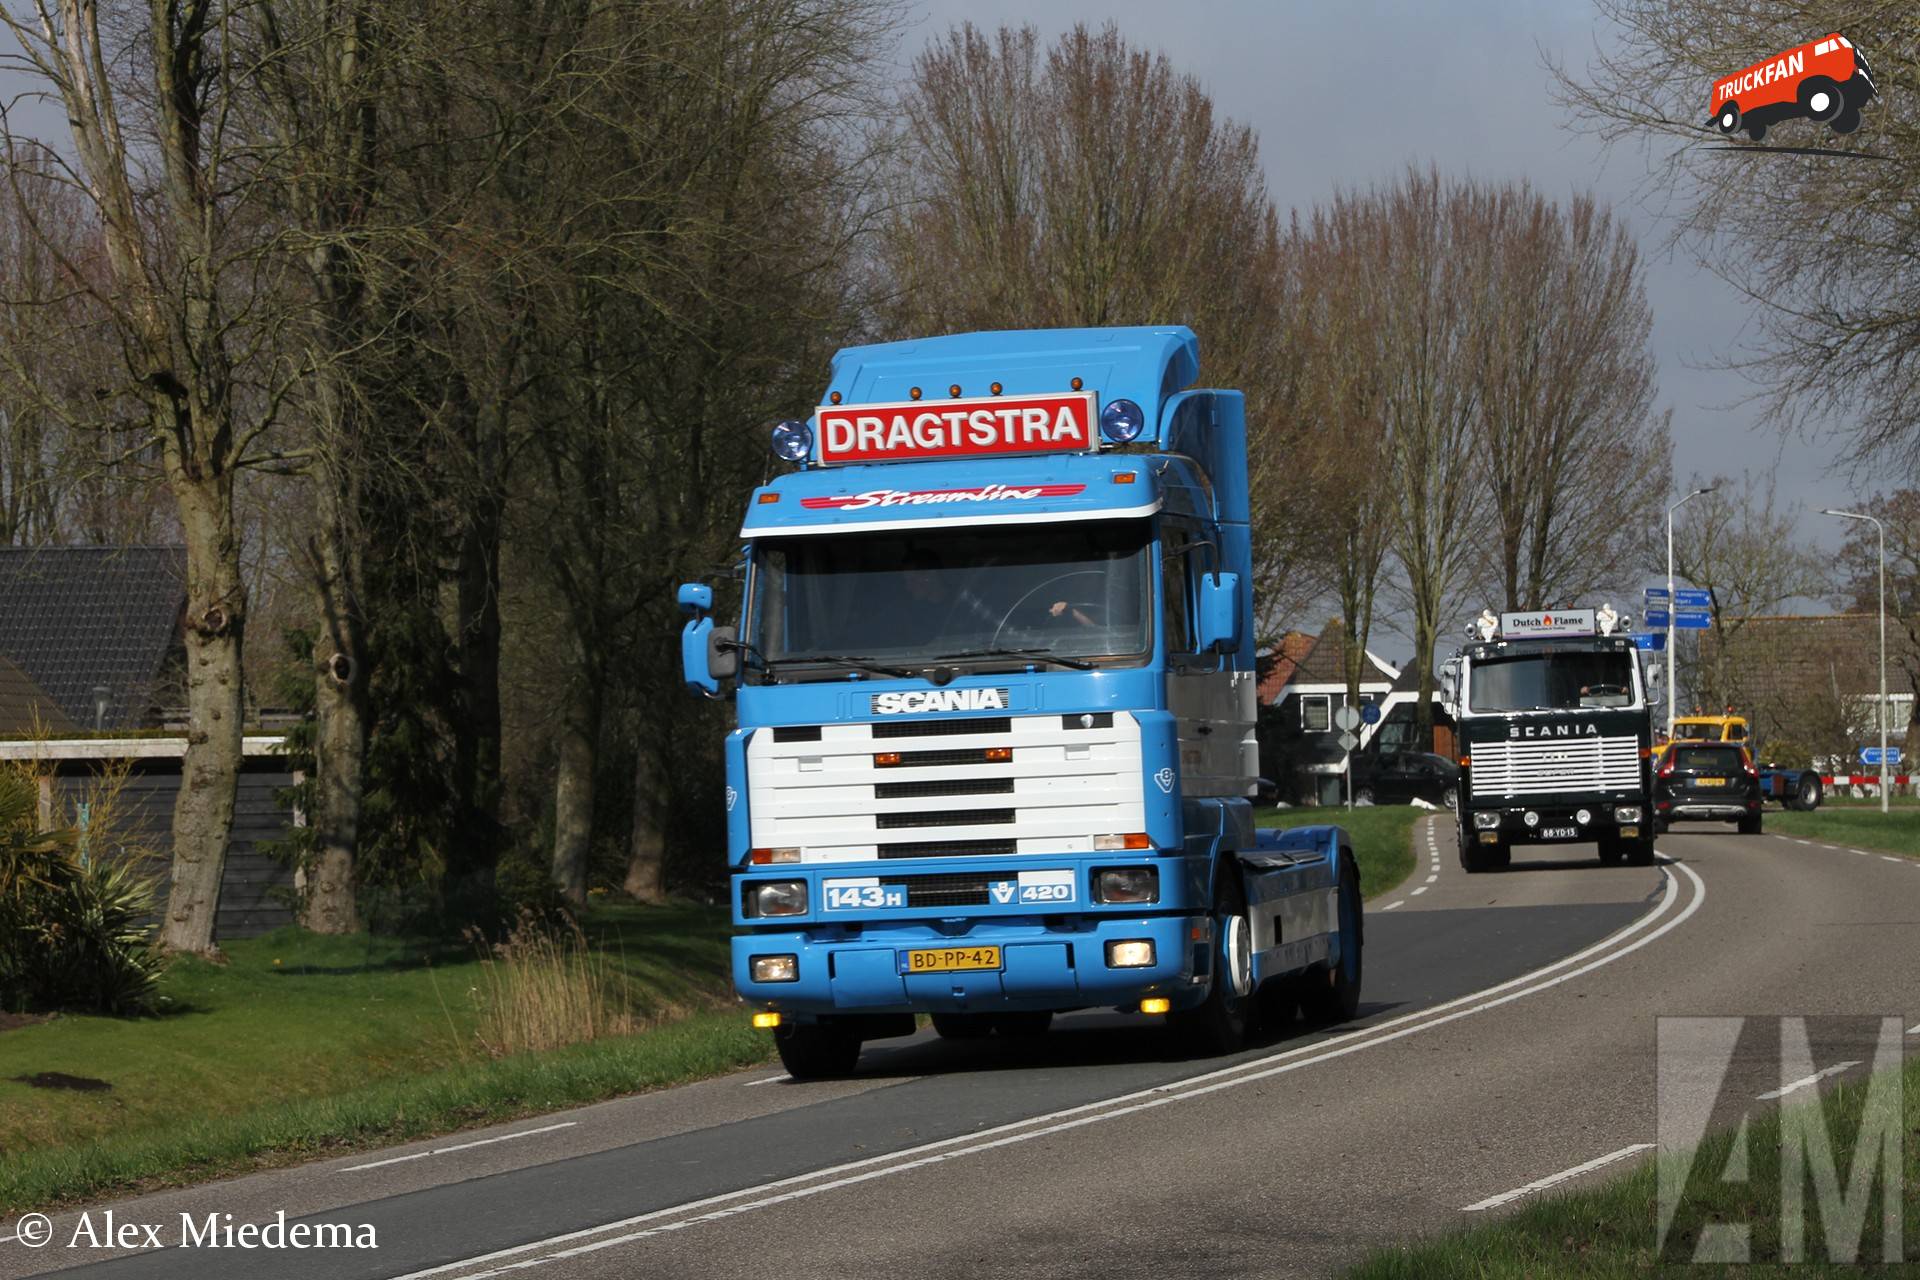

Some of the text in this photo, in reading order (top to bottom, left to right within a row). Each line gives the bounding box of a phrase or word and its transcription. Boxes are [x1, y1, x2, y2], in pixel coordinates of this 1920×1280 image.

[826, 406, 1083, 453] DRAGTSTRA
[830, 484, 1043, 511] Streamline
[1512, 616, 1584, 628] Dutch Flame
[877, 688, 1004, 714] SCANIA
[1509, 724, 1598, 737] SCANIA
[1022, 885, 1068, 900] 420
[913, 949, 995, 968] BD-PP-42
